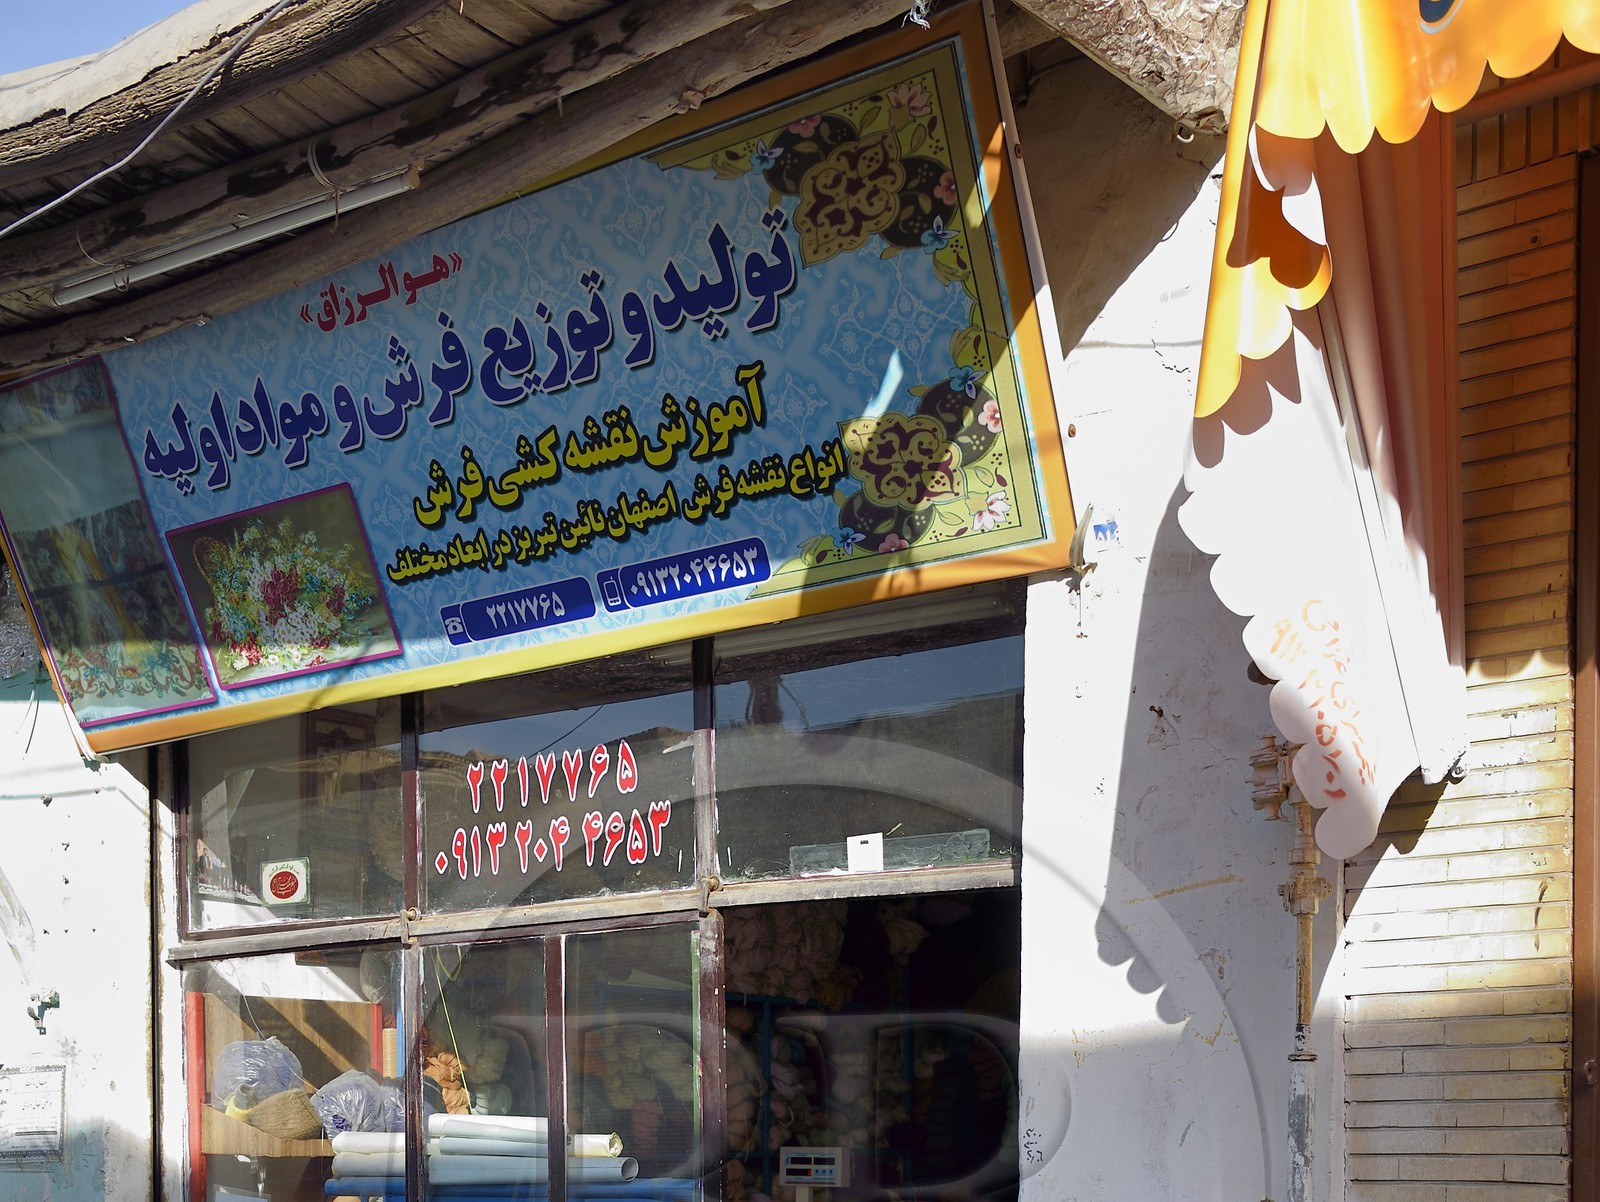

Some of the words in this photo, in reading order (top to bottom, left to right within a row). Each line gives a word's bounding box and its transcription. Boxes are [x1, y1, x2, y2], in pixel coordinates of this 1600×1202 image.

[651, 208, 796, 338] تولید
[479, 269, 611, 405] توزیع
[619, 290, 653, 367] و
[362, 311, 471, 439] فرش
[143, 391, 236, 493] اولیه
[234, 376, 330, 468] مواد
[332, 384, 364, 452] و
[563, 407, 641, 470] نقشه
[641, 360, 764, 469] آموزش
[414, 446, 487, 527] فرش
[487, 426, 559, 507] کشی
[683, 465, 735, 521] فرش
[735, 454, 788, 498] نقشه
[789, 438, 846, 494] انواع
[512, 513, 559, 562] تبریز
[558, 500, 606, 550] نائین
[606, 480, 679, 539] اصفهان
[386, 543, 448, 582] مختلف
[448, 528, 489, 569] ابعاد
[491, 528, 513, 567] در
[629, 545, 758, 598] ۰۹۱۳۲۰۴۴۶۵۳
[484, 590, 566, 631] ۲۲۱۷۷۶۵
[466, 739, 638, 814] ۲۲۱۷۷۶۵
